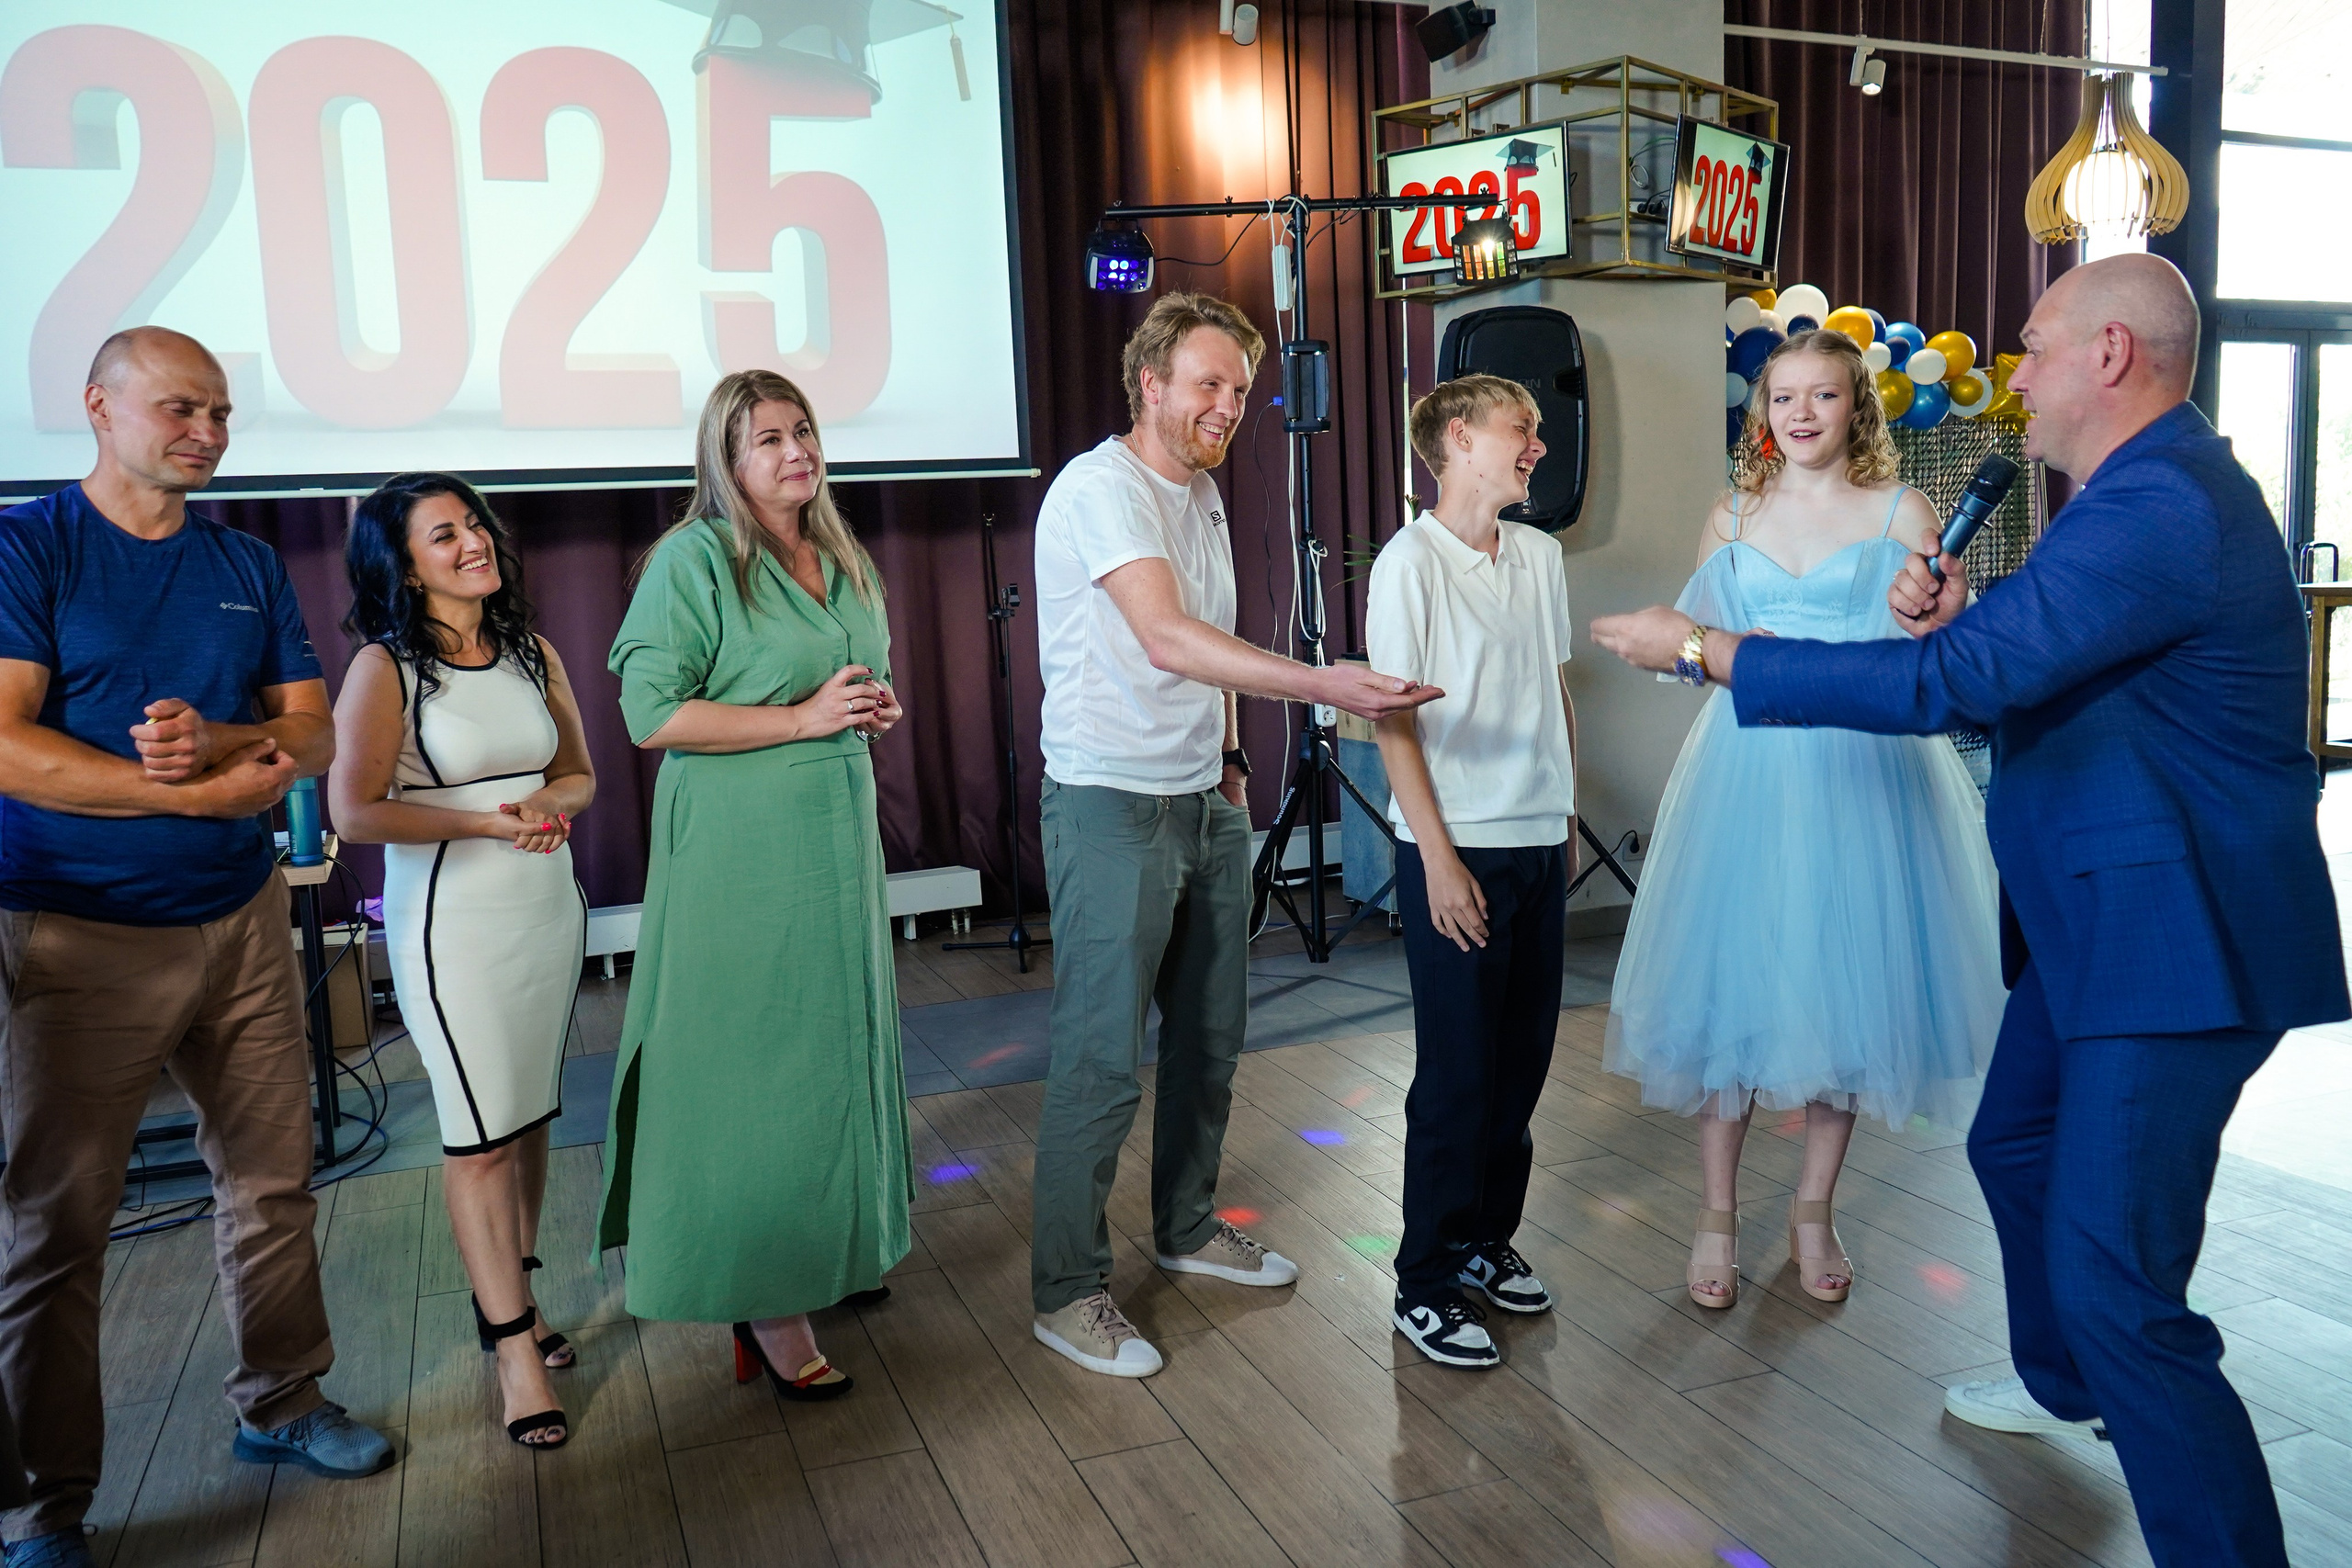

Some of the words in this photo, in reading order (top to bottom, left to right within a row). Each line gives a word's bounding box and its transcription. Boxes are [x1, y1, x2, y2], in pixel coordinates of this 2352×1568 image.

[1, 24, 892, 432] 2025
[1689, 154, 1759, 255] 2025
[1272, 786, 1295, 825] Soundking
